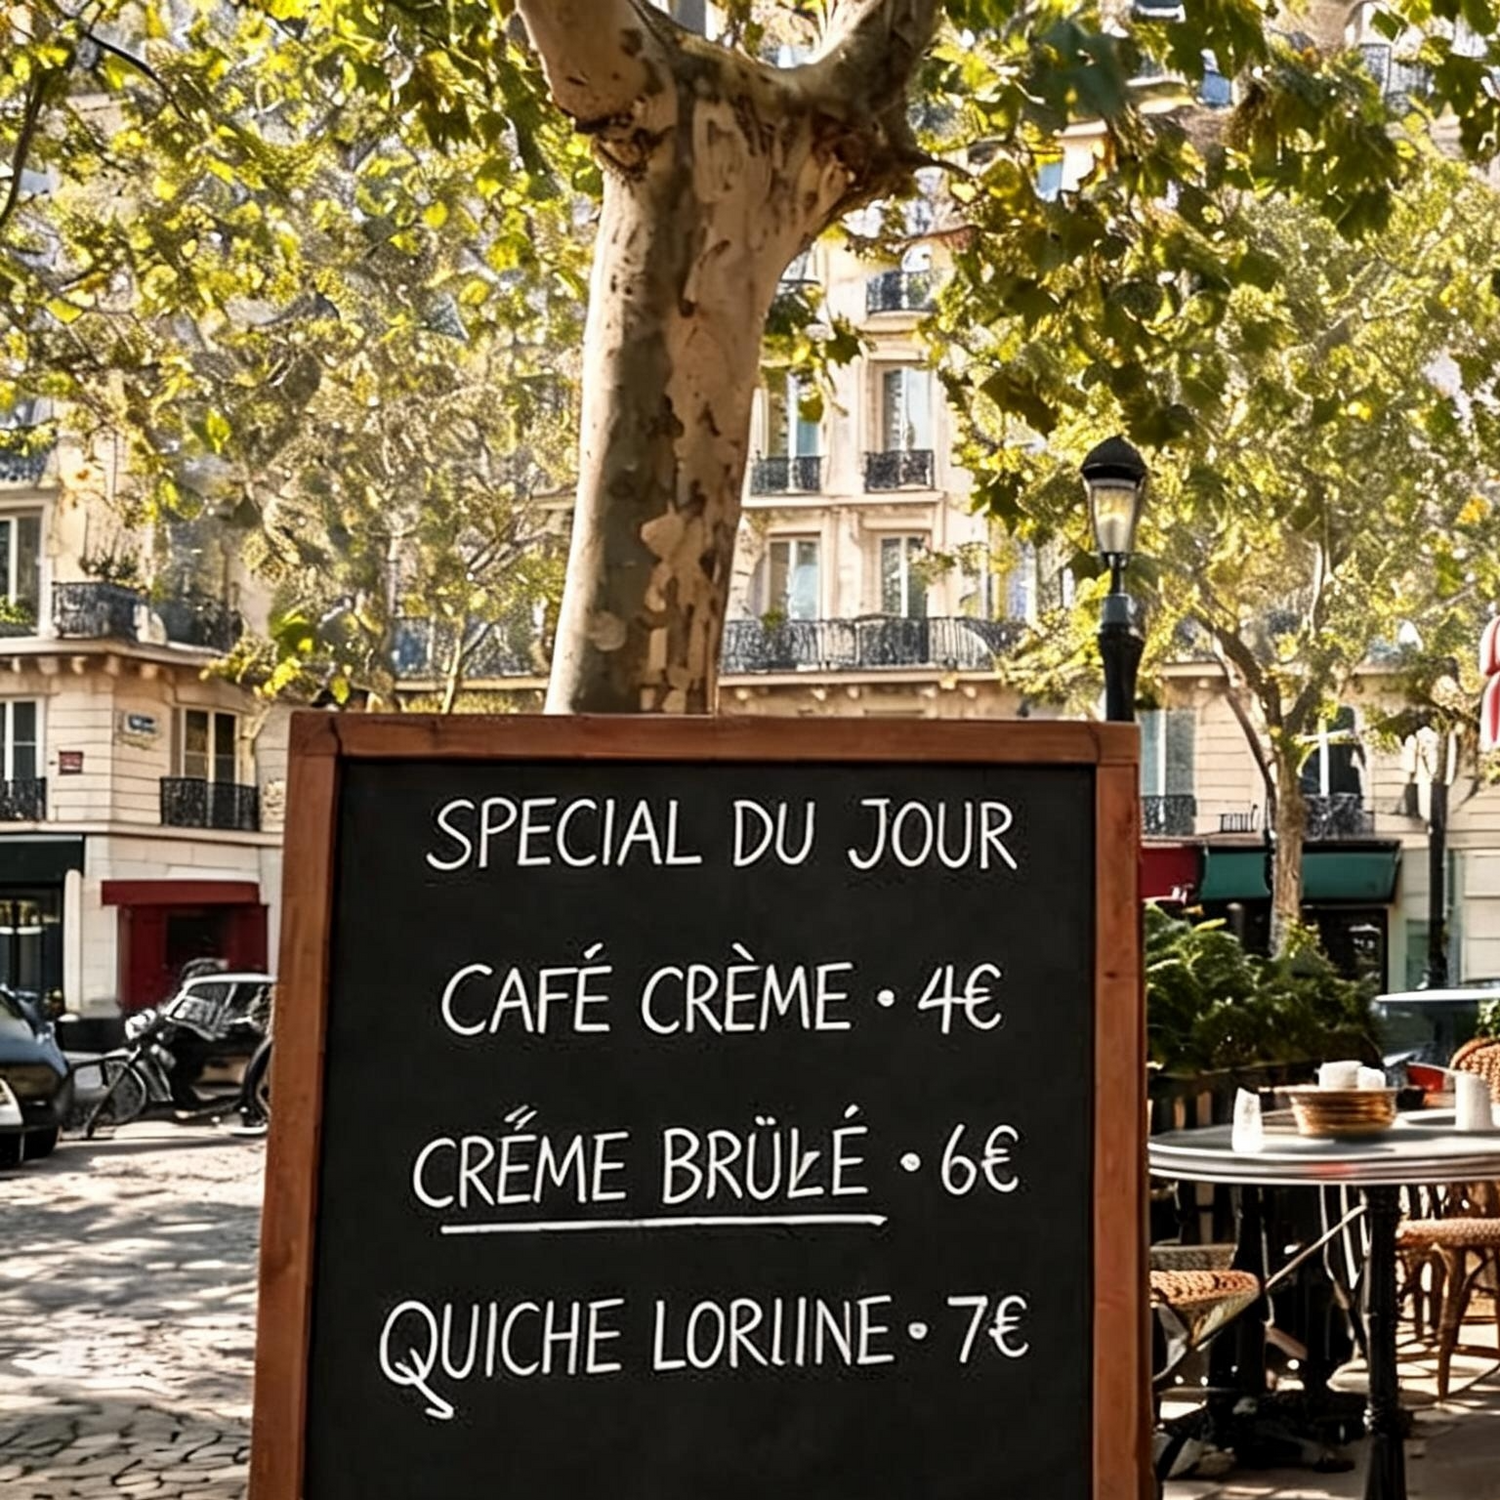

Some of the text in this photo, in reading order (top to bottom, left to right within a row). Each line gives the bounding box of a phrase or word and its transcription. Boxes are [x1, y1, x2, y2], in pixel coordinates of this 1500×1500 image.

[427, 798, 1018, 871] SPECIAL DU JOUR
[441, 942, 613, 1036] CAFÉ
[641, 942, 853, 1034] CRÈME
[917, 962, 1002, 1035] 4€
[941, 1123, 1019, 1196] 6€
[379, 1298, 625, 1420] QUICHE
[947, 1295, 1029, 1364] 7€
